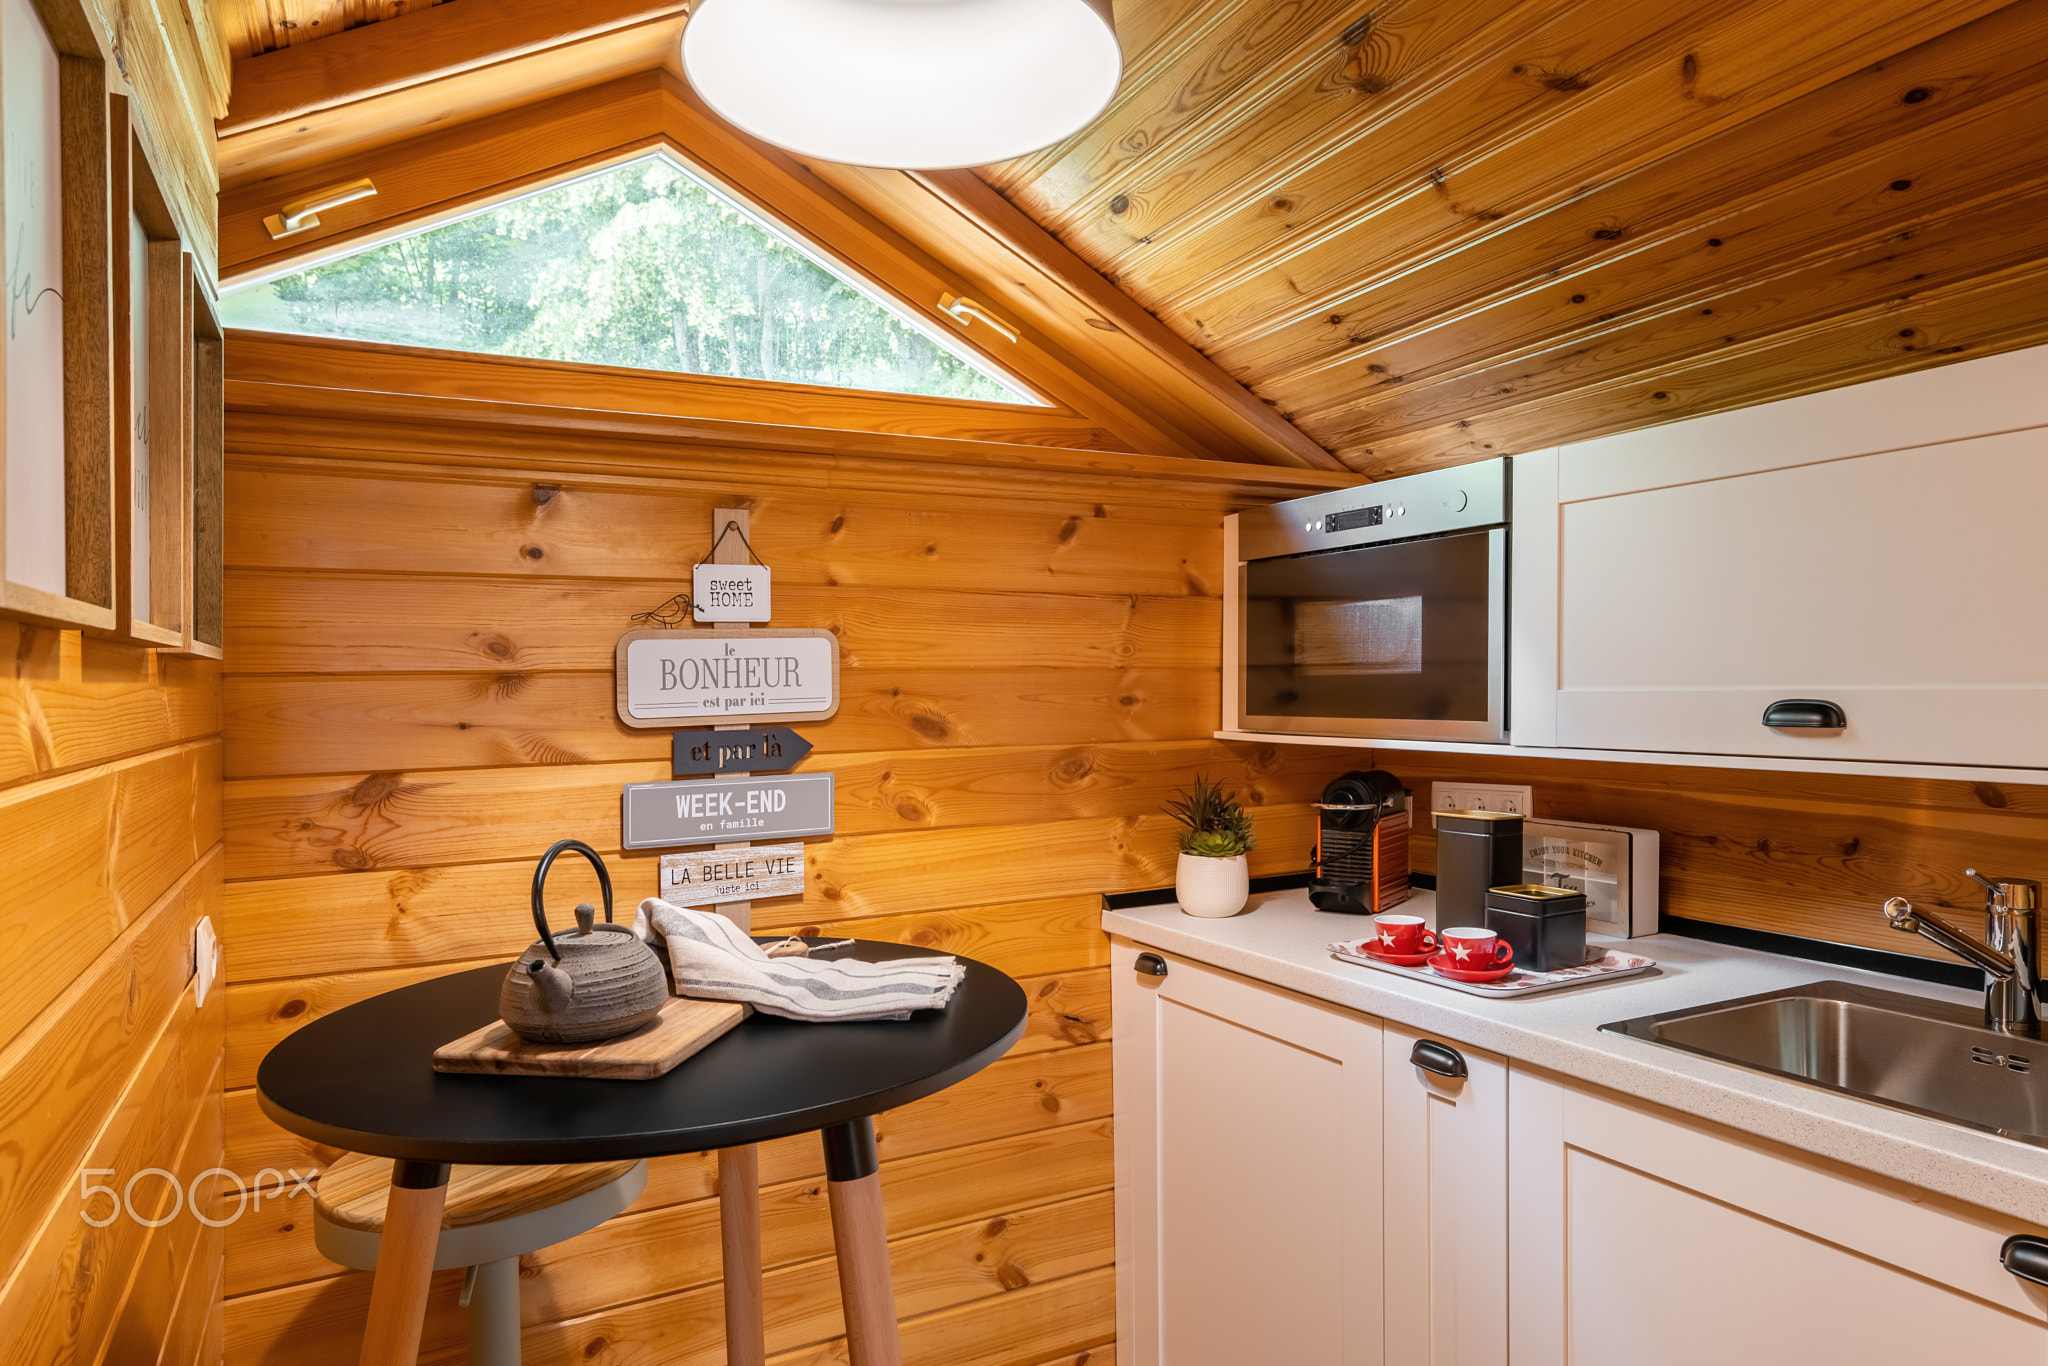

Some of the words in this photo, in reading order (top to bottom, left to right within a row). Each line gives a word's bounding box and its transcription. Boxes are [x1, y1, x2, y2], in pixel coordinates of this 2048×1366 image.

[710, 578, 753, 591] sweet
[709, 592, 754, 608] HOME
[724, 643, 736, 657] le
[659, 656, 803, 691] BONHEUR
[702, 696, 721, 708] est
[724, 696, 747, 711] par
[750, 693, 765, 707] ici
[690, 741, 711, 762] et
[718, 743, 757, 769] par
[763, 733, 783, 759] là
[675, 789, 787, 819] WEEK-END
[700, 821, 713, 831] en
[719, 818, 765, 830] famille
[1528, 846, 1550, 858] ENJOY
[1551, 845, 1570, 855] YOUR
[1572, 847, 1604, 868] KITCHEN
[671, 868, 692, 886] LA
[703, 861, 755, 882] BELLE
[765, 856, 796, 876] VIE
[714, 884, 741, 897] juste
[745, 881, 760, 892] ici
